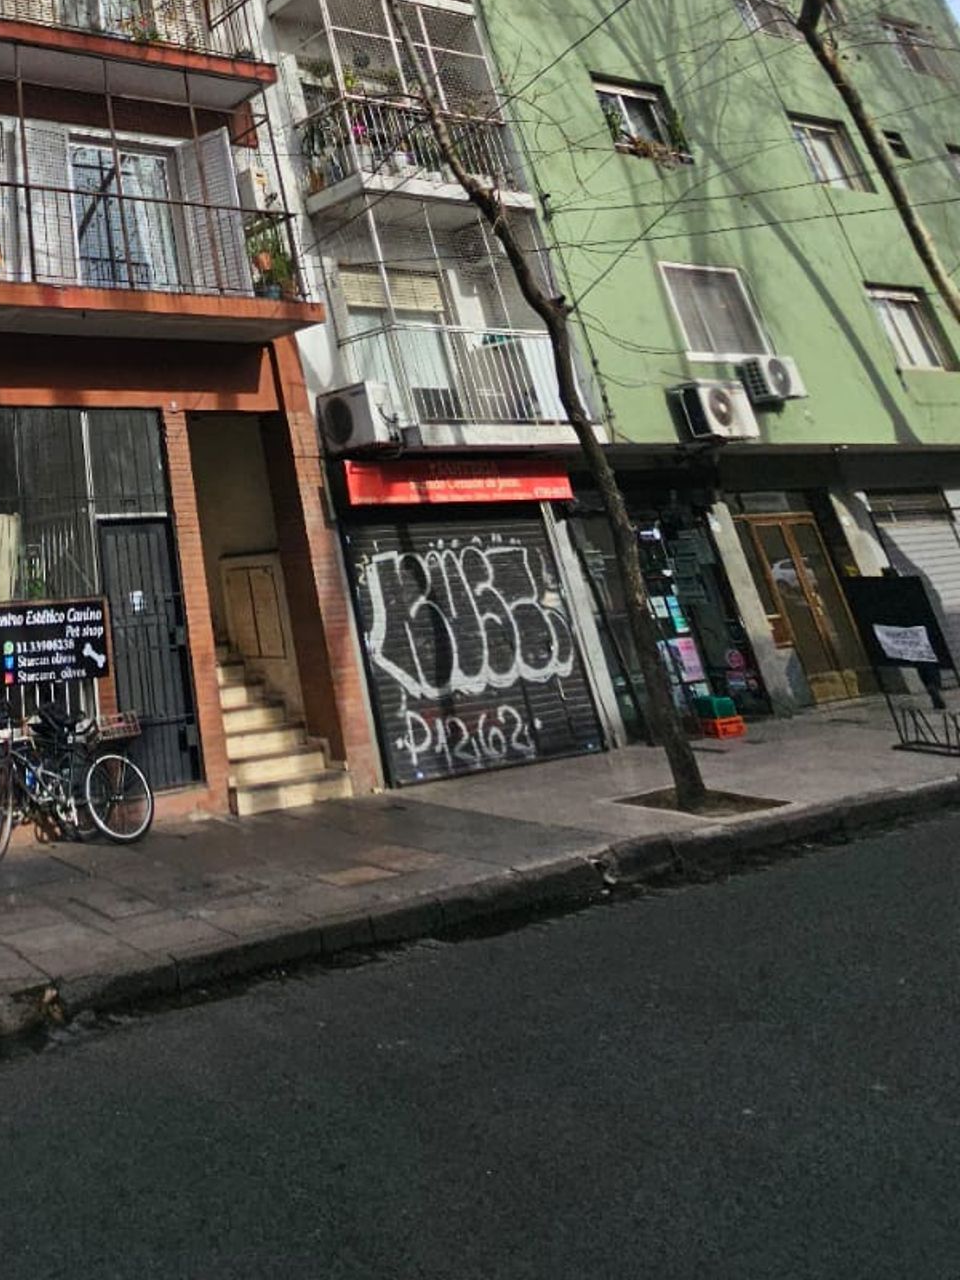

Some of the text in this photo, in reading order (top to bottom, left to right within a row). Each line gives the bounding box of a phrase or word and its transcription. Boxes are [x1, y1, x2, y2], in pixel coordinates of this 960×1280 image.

[67, 607, 102, 623] Canino
[65, 624, 104, 638] Pet shop
